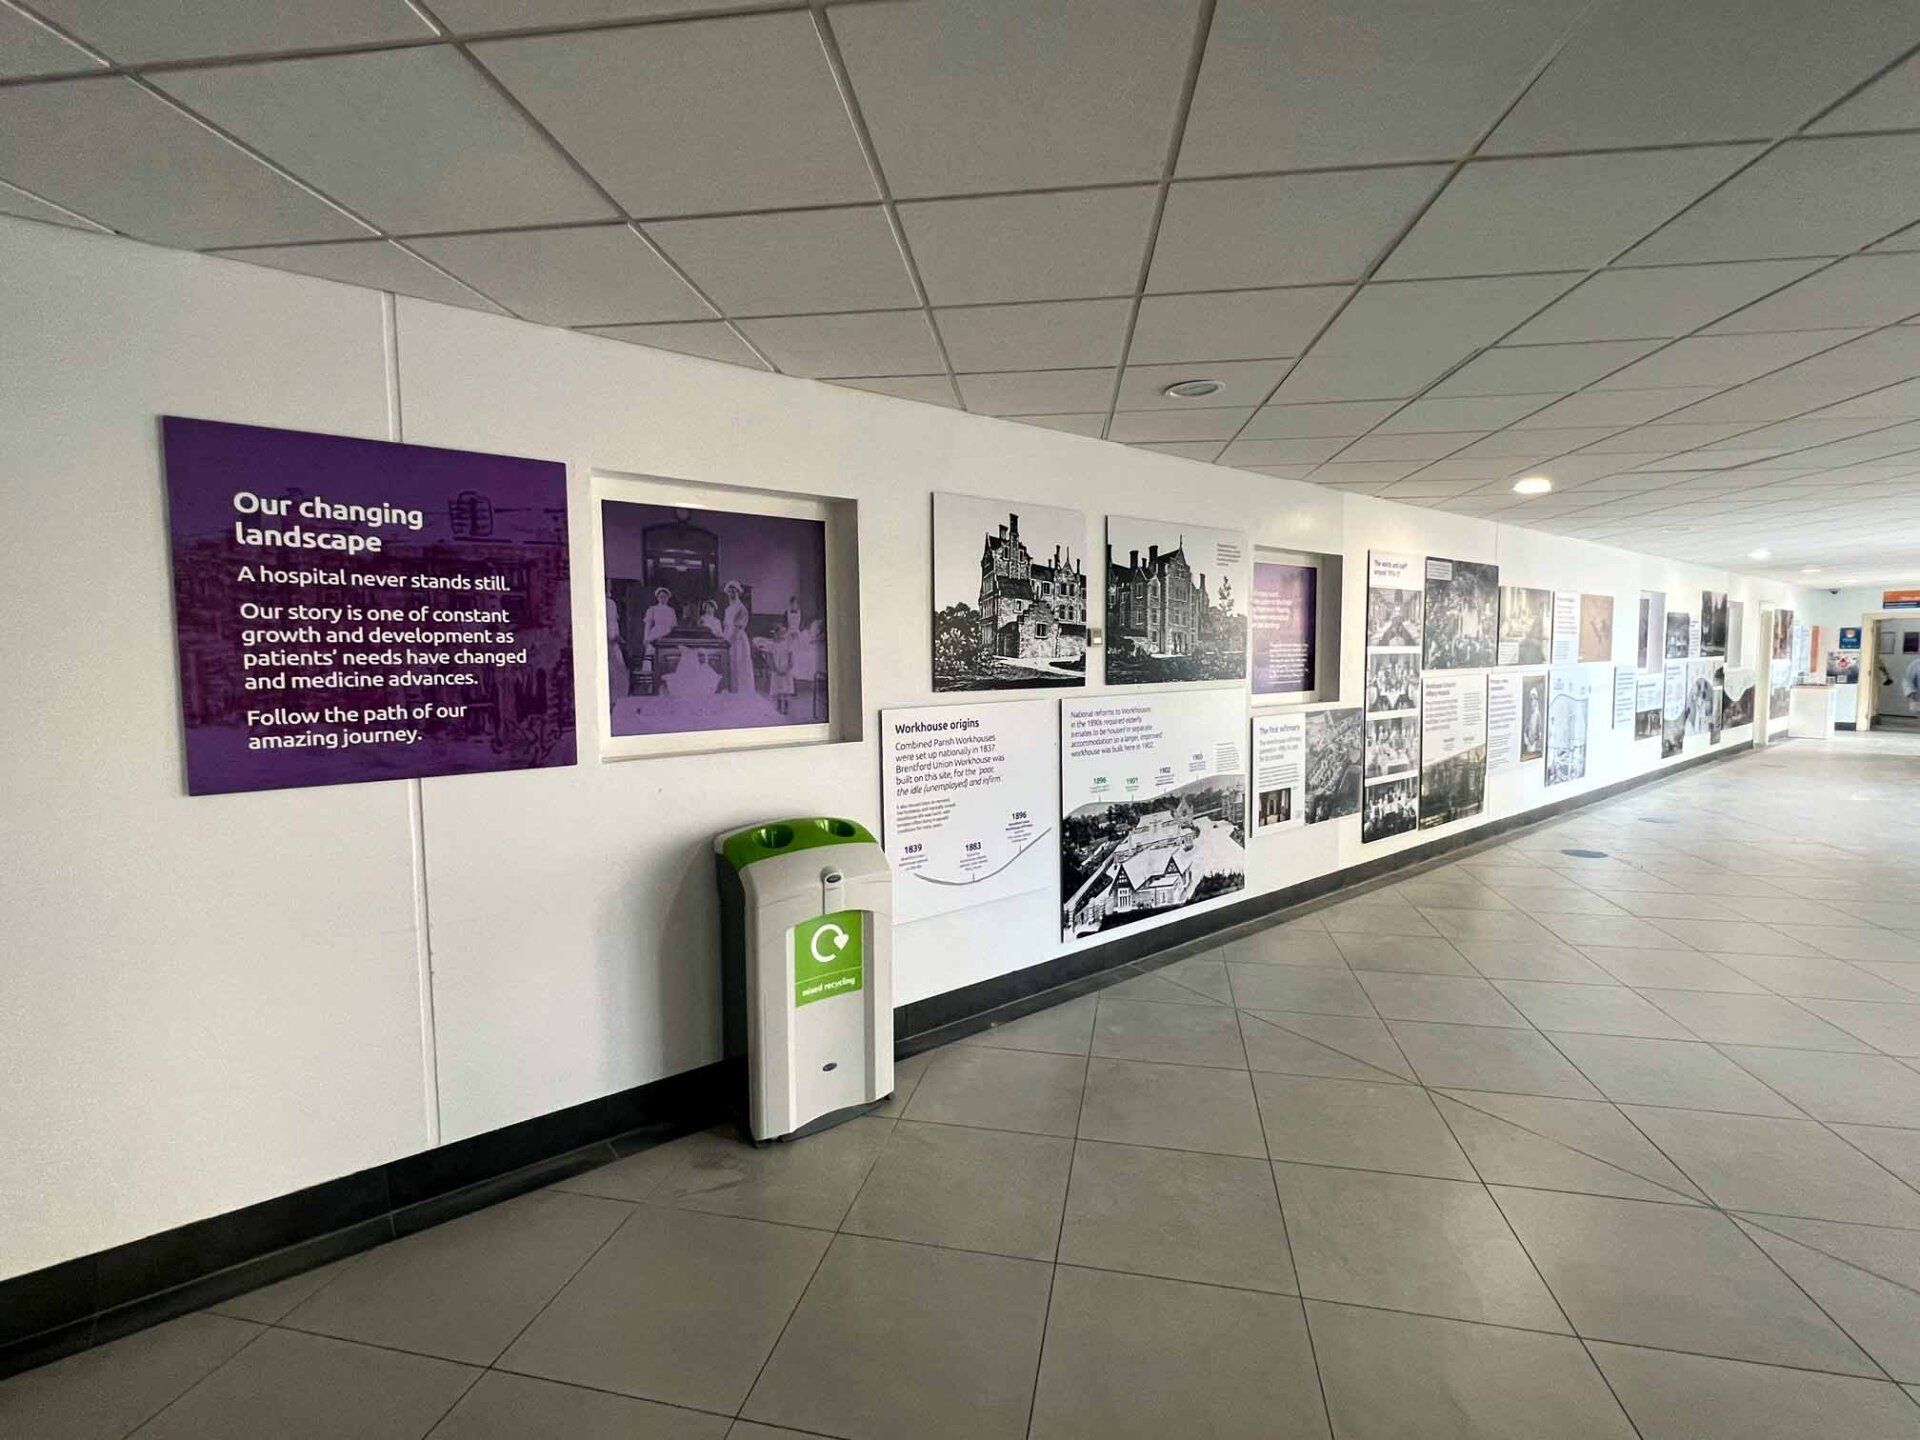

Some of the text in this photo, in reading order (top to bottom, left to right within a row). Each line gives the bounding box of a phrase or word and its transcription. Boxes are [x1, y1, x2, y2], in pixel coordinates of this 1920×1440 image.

[233, 491, 423, 531] Our changing
[235, 521, 382, 555] landscape
[237, 565, 511, 591] A hospital never stands still.
[240, 602, 510, 624] Our story is one of constant
[241, 625, 515, 647] growth and development as
[243, 648, 527, 670] patients' needs have changed
[244, 670, 479, 690] and medicine advances.
[247, 702, 468, 727] Follow the path of our
[1094, 708, 1114, 716] reforms
[895, 718, 979, 734] Workhouse origins
[248, 728, 423, 750] amazing journey.
[895, 734, 996, 751] Combined Parish Workhouses
[1071, 738, 1113, 748] accommodation
[896, 754, 914, 762] were
[916, 752, 926, 760] set
[939, 747, 971, 756] nationally
[1071, 749, 1100, 757] workhouse
[1112, 745, 1123, 753] built
[896, 761, 931, 773] Brentford
[933, 761, 953, 769] Union
[954, 755, 991, 766] Workhouse
[896, 776, 913, 785] built
[925, 773, 937, 781] this
[954, 769, 963, 777] for
[897, 787, 909, 796] the
[911, 786, 922, 794] idle
[924, 779, 968, 794] (unemployed)
[969, 778, 981, 786] and
[1012, 811, 1027, 820] 1896
[904, 843, 922, 854] 1839
[965, 842, 981, 852] 1883
[802, 978, 856, 996] mixed recycling
